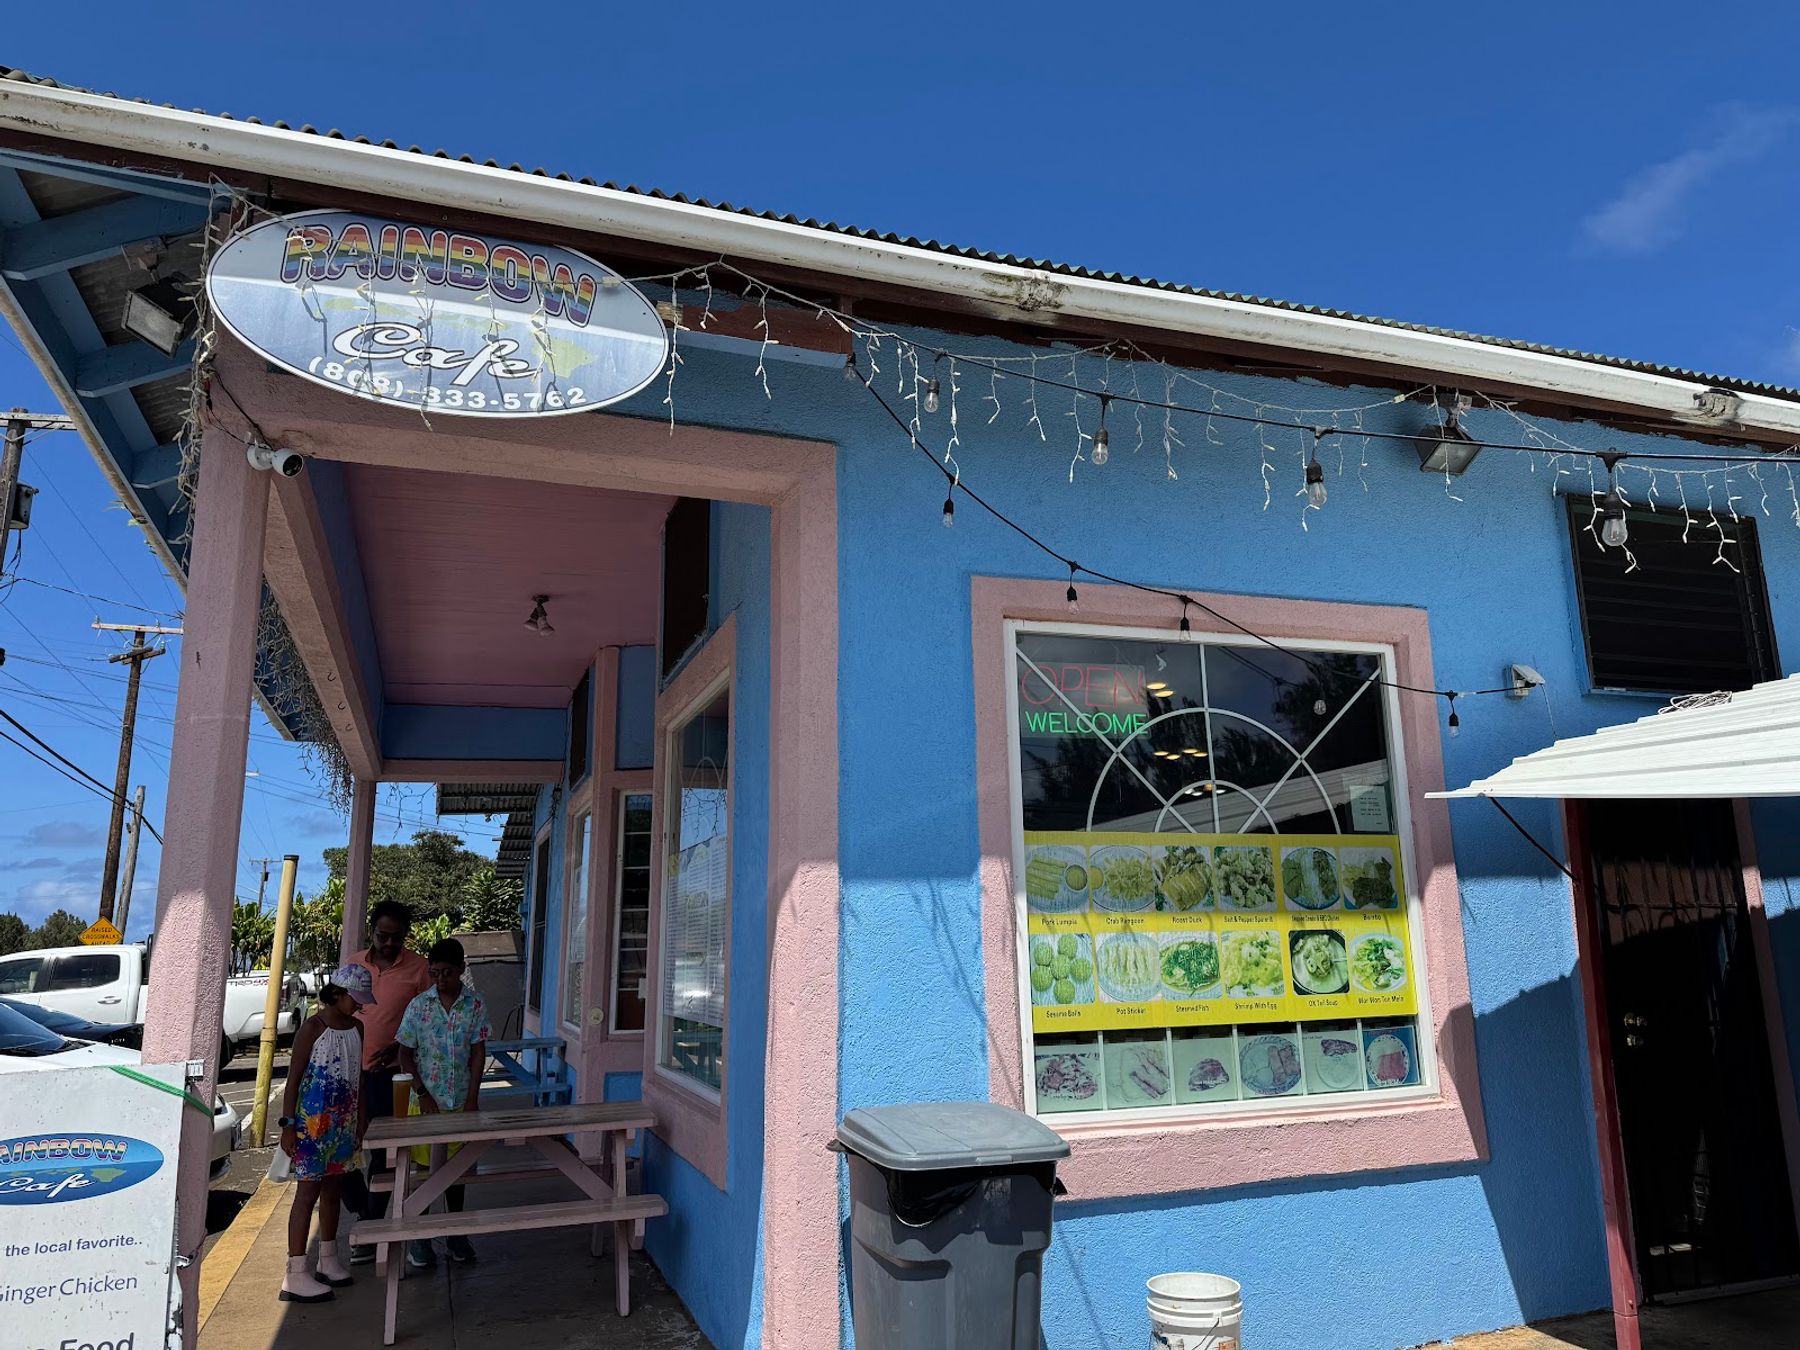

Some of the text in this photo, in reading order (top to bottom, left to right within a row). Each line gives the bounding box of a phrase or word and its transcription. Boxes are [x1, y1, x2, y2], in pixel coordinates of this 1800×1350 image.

[280, 222, 597, 328] RAINBOW
[332, 321, 543, 387] Cafe
[308, 356, 586, 410] (808) 333-5762
[1021, 664, 1143, 708] OPEN
[1025, 711, 1148, 735] WELCOME
[0, 1173, 95, 1198] Cafe
[5, 1234, 143, 1257] the local favorite..
[0, 1274, 138, 1305] inger Chicken
